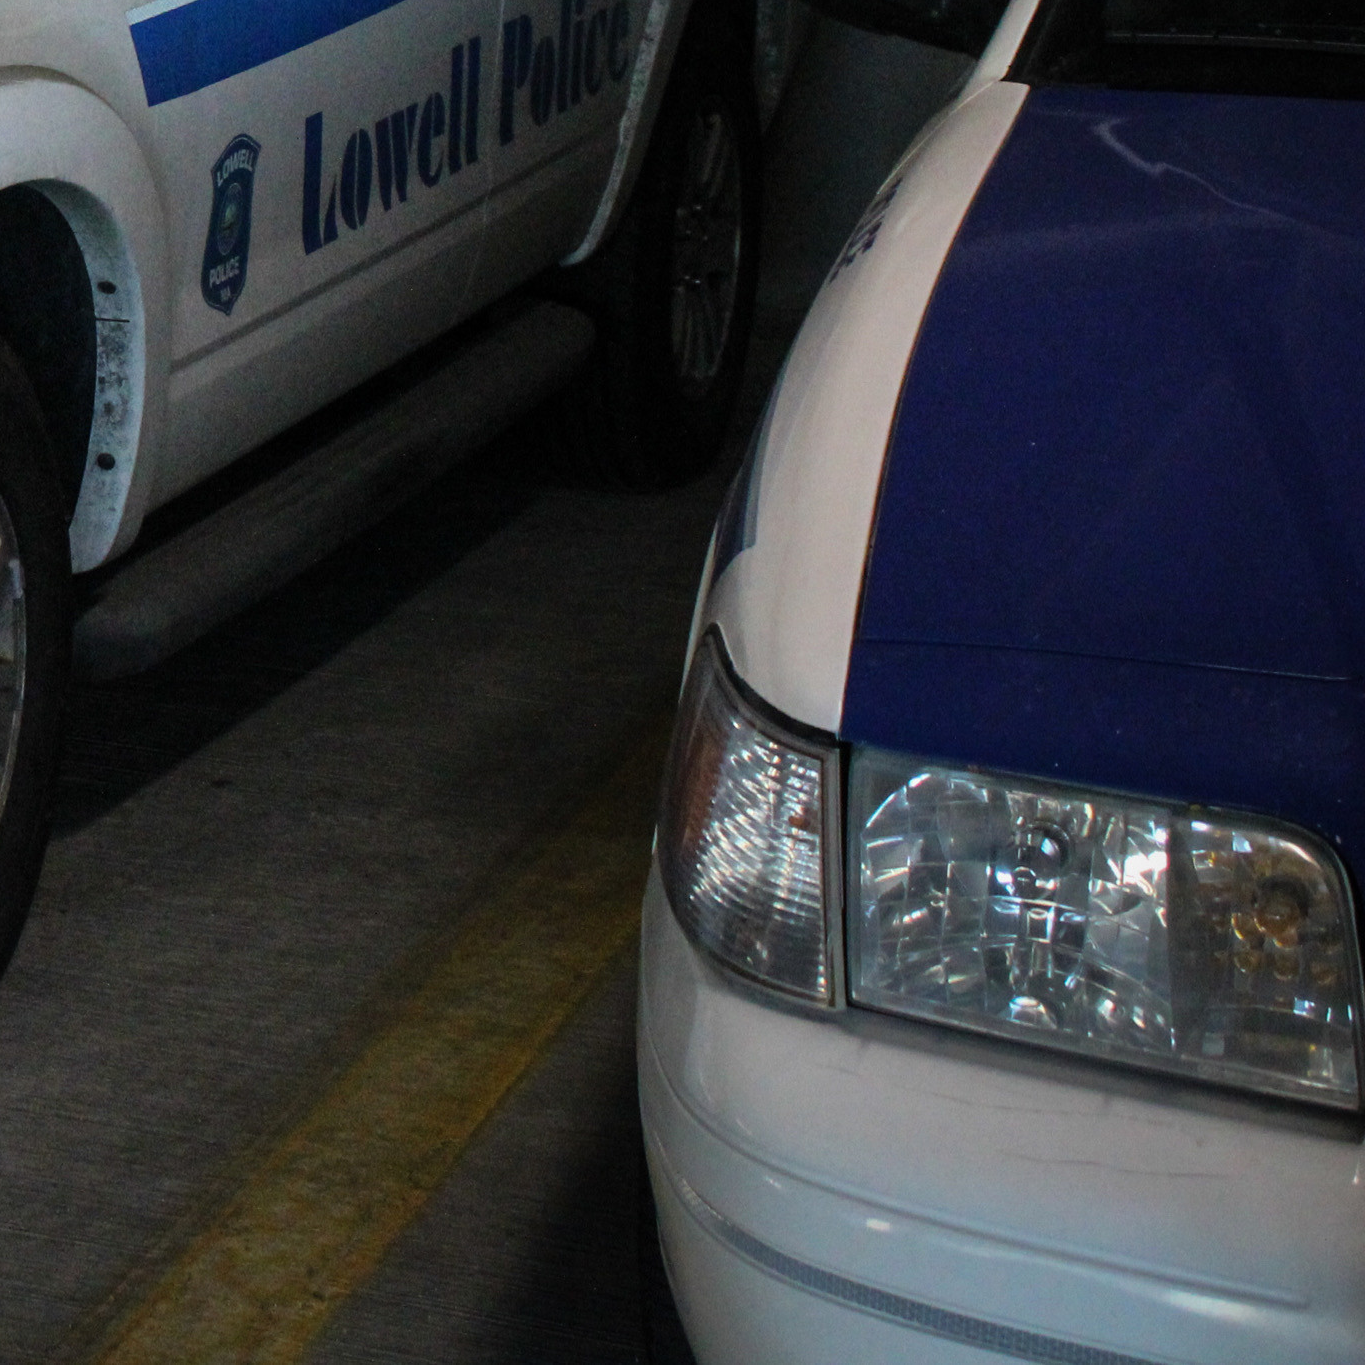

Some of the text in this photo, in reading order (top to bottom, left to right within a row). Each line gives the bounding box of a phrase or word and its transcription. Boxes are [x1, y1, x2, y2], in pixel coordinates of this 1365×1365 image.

[302, 36, 481, 255] Lowell
[217, 148, 254, 187] LOWELL
[209, 256, 240, 288] POLICE
